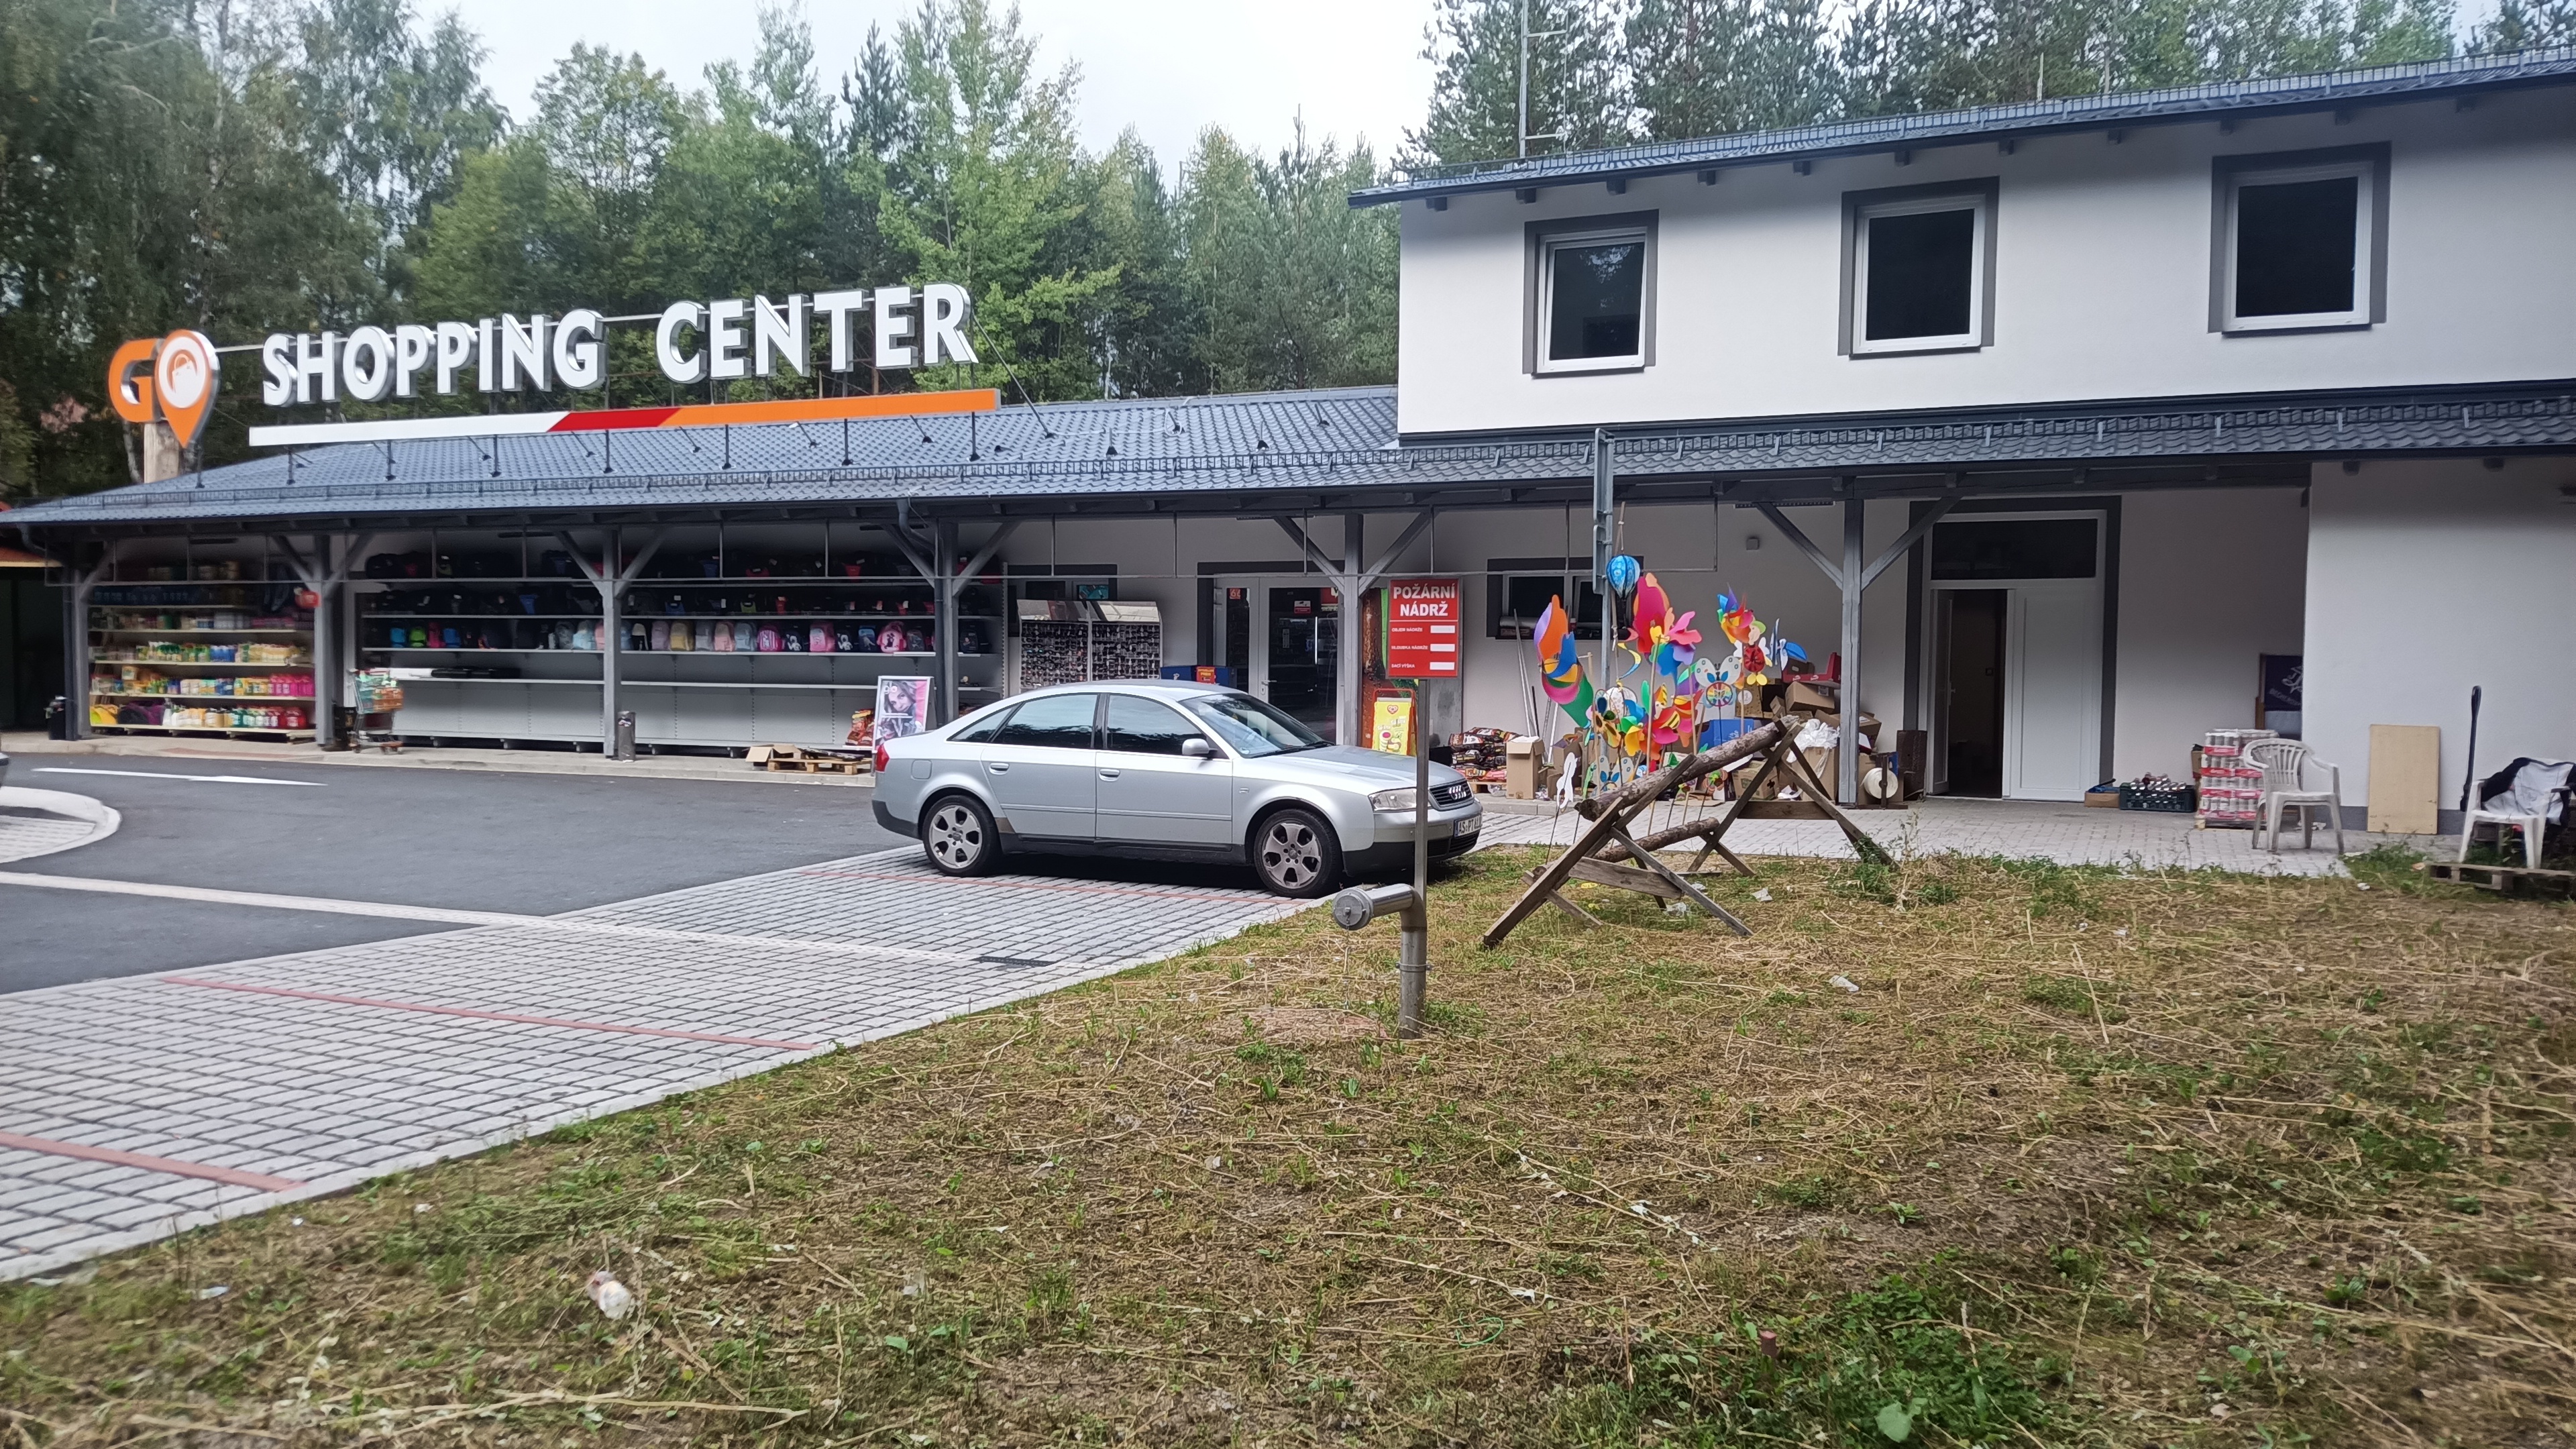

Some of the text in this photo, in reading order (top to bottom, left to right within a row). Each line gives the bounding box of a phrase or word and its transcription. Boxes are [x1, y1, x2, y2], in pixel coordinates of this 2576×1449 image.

[262, 309, 608, 407] SHOPPING
[655, 282, 979, 384] CENTER
[1393, 583, 1455, 599] POŽÁRNÍ
[1400, 600, 1448, 616] NÁDRŽ
